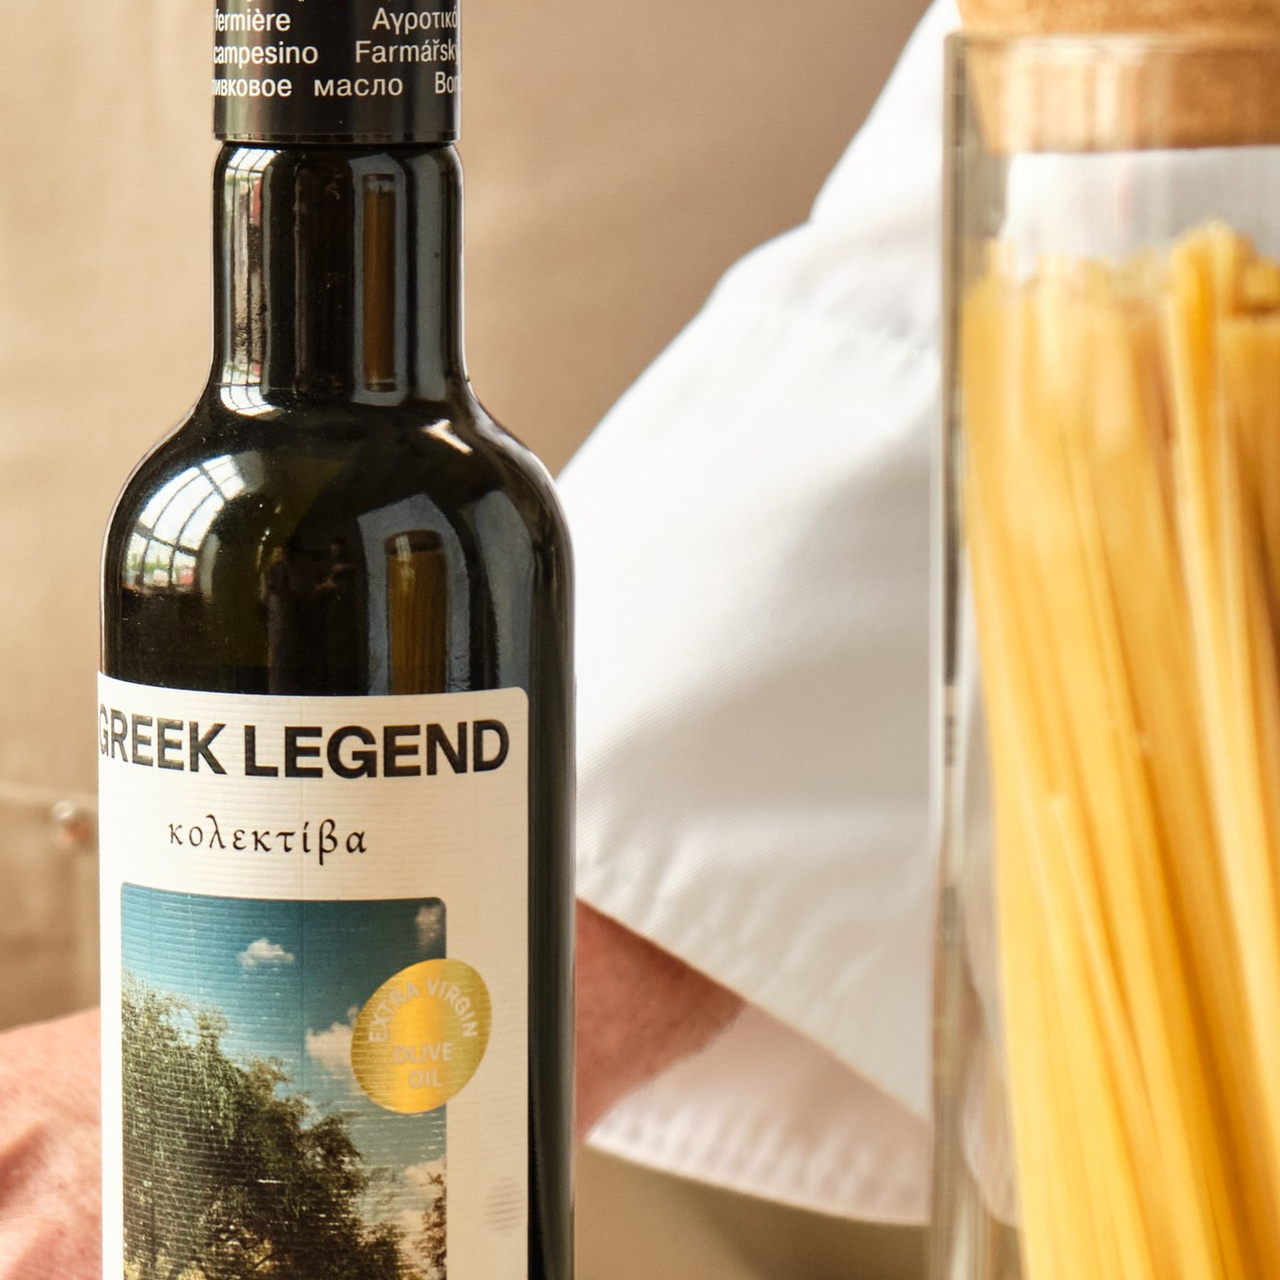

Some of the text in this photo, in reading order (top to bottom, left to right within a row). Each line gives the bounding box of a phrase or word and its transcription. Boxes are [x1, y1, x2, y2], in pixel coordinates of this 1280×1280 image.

[215, 8, 291, 32] fermière
[213, 40, 319, 69] campesino
[314, 77, 403, 97] масло
[100, 703, 510, 779] GREEK LEGEND
[168, 814, 368, 865] κολεκτίβα
[368, 976, 478, 1043] EXTRA VIRGIN
[393, 1042, 454, 1064] OLIVE
[408, 1069, 442, 1088] OIL
